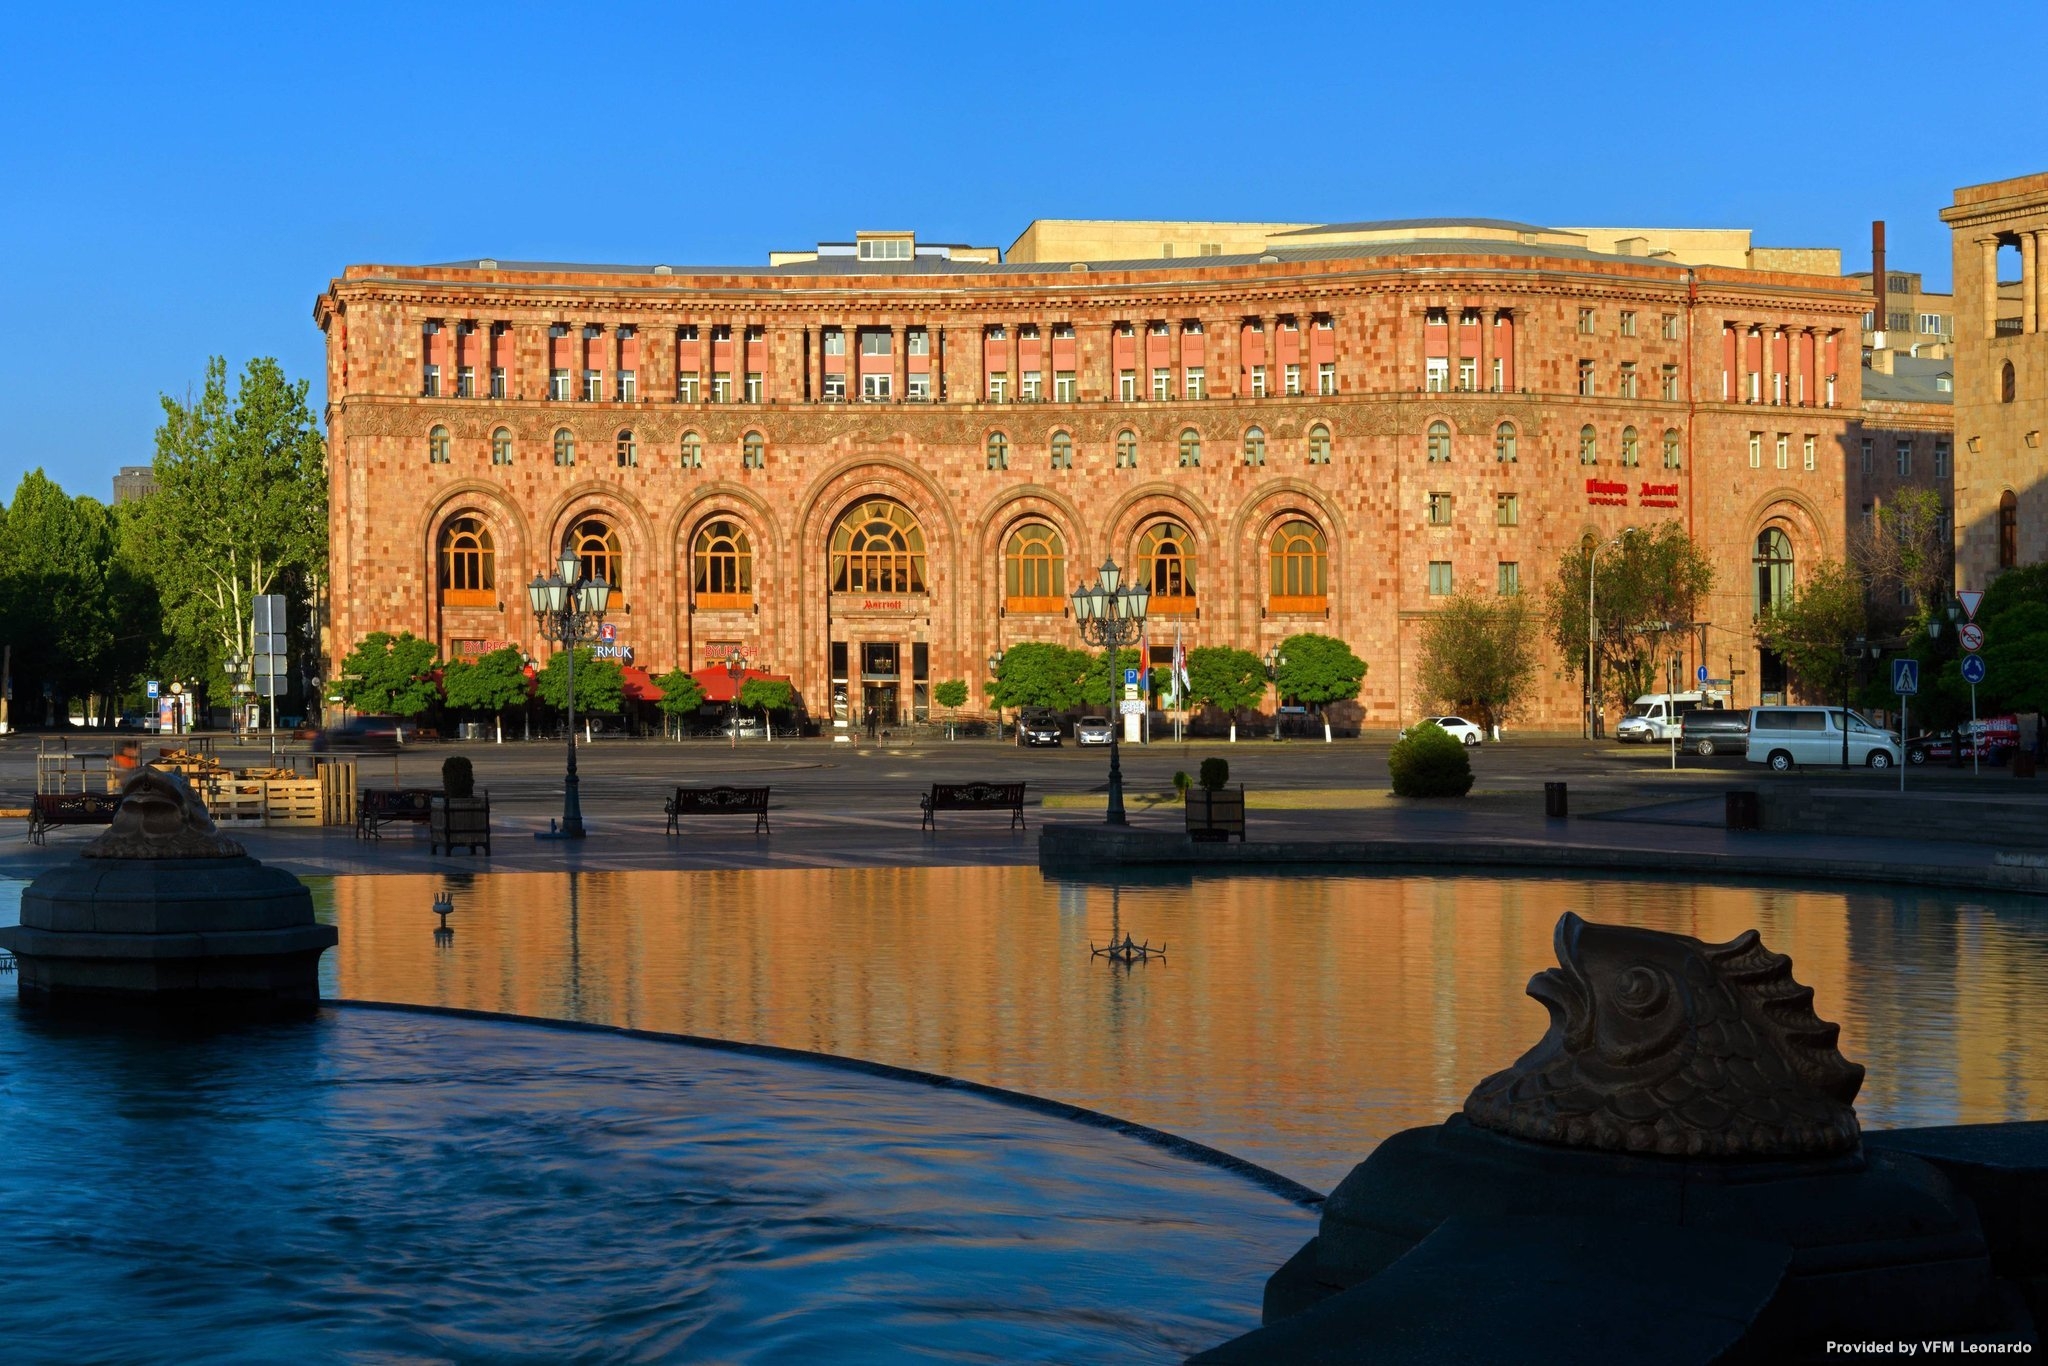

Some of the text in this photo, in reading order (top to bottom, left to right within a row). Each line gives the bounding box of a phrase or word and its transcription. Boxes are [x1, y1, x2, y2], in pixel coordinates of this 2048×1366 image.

[1638, 482, 1679, 497] Marriott
[863, 600, 902, 610] Marriott
[464, 641, 511, 653] BYUREG
[705, 645, 758, 657] BYURGH
[1128, 671, 1135, 683] P
